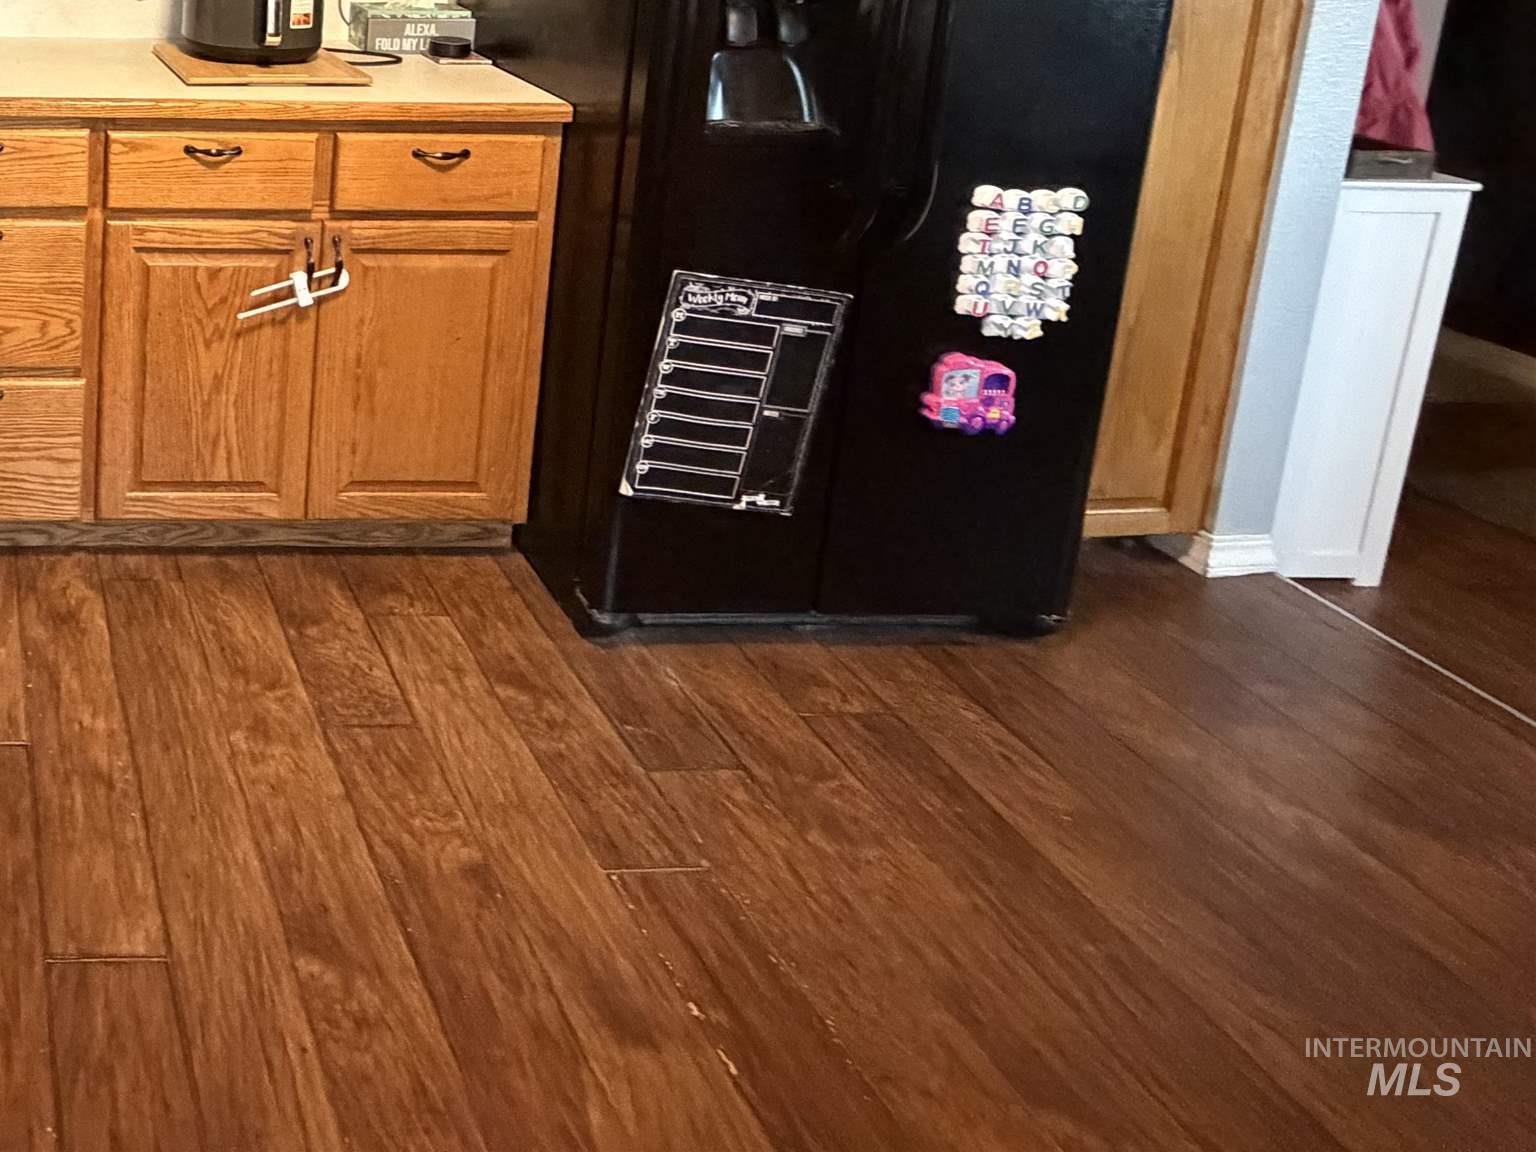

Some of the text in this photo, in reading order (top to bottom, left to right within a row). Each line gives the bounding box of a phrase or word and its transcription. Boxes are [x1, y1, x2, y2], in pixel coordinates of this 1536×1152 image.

[375, 38, 399, 51] FOLD
[401, 38, 418, 51] MY
[990, 193, 1004, 208] A
[1018, 197, 1032, 212] B
[1074, 196, 1088, 210] D
[985, 217, 1000, 233] E
[1039, 219, 1054, 234] G
[979, 239, 1048, 255] I J K
[977, 260, 995, 276] M
[1007, 260, 1021, 277] N
[1033, 260, 1048, 276] O
[1031, 282, 1047, 296] S
[687, 293, 724, 305] Weekly
[972, 301, 988, 317] U
[1002, 300, 1016, 315] V
[1026, 302, 1045, 317] W
